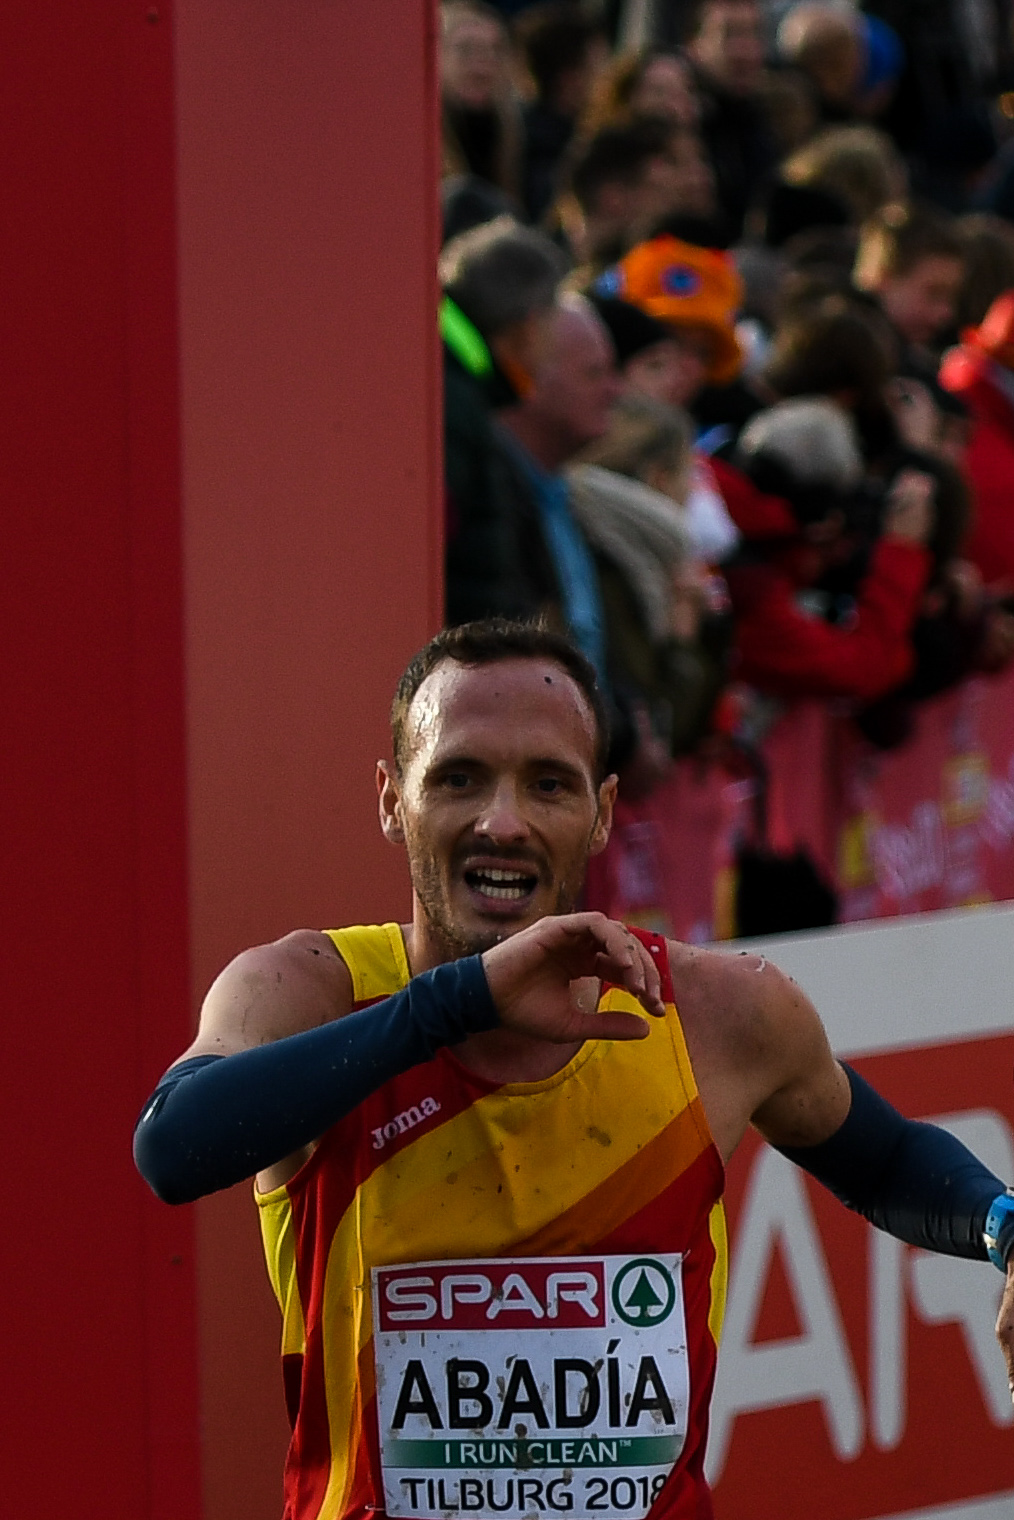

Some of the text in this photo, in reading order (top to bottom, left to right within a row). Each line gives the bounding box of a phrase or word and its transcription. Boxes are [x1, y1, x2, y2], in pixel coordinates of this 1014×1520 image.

[385, 1271, 600, 1321] SPAR
[391, 1338, 677, 1430] ABADÍA
[445, 1442, 451, 1464] I
[460, 1441, 518, 1464] RUN
[400, 1476, 574, 1512] TILBURG
